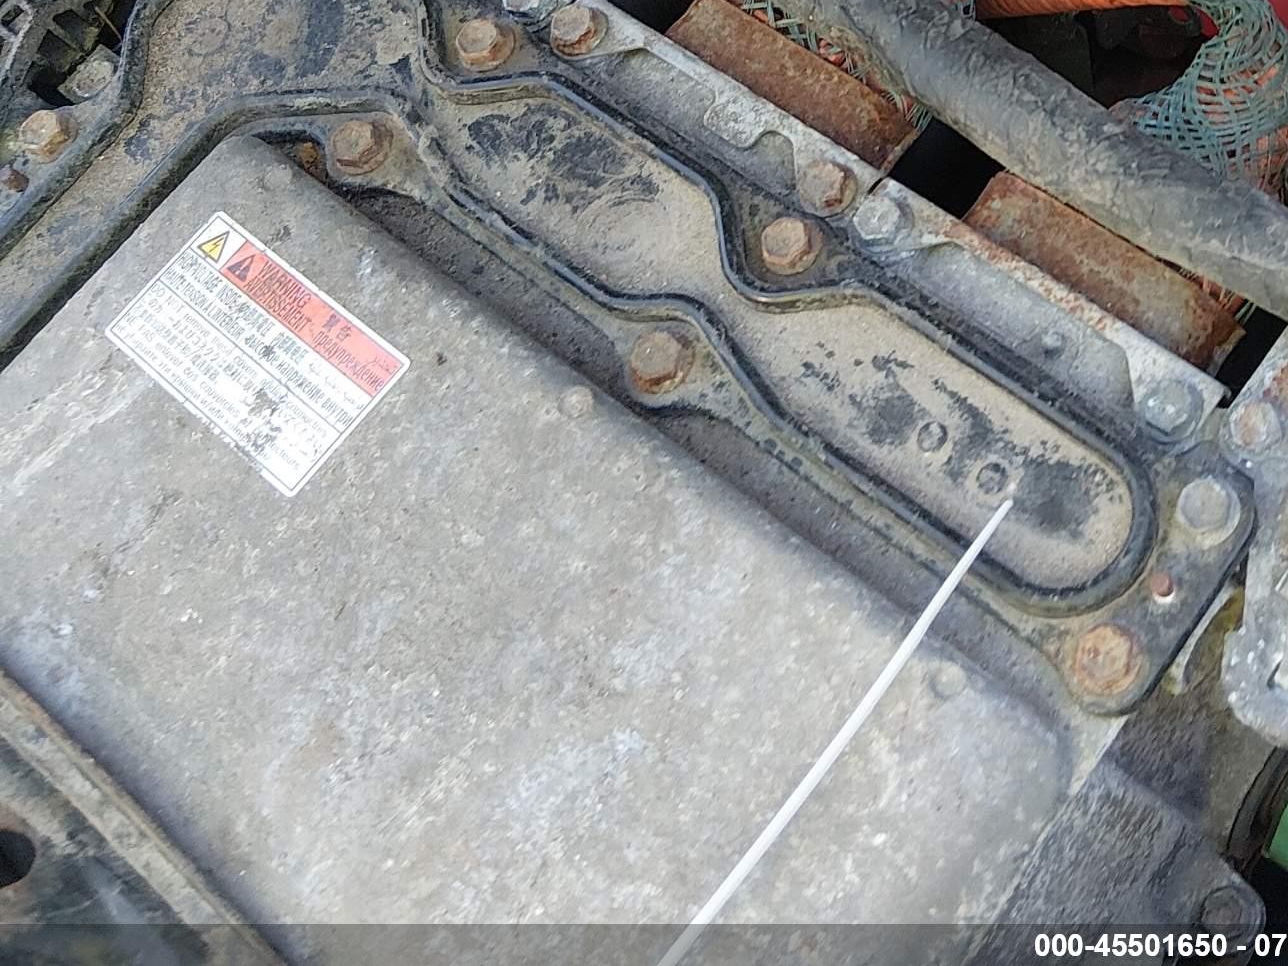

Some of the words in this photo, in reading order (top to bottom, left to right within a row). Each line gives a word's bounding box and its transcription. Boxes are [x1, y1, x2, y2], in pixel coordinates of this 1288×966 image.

[150, 283, 166, 298] DO
[164, 294, 184, 313] NOT
[244, 274, 310, 332] AVERTISSEMENT
[257, 261, 311, 308] WARNING
